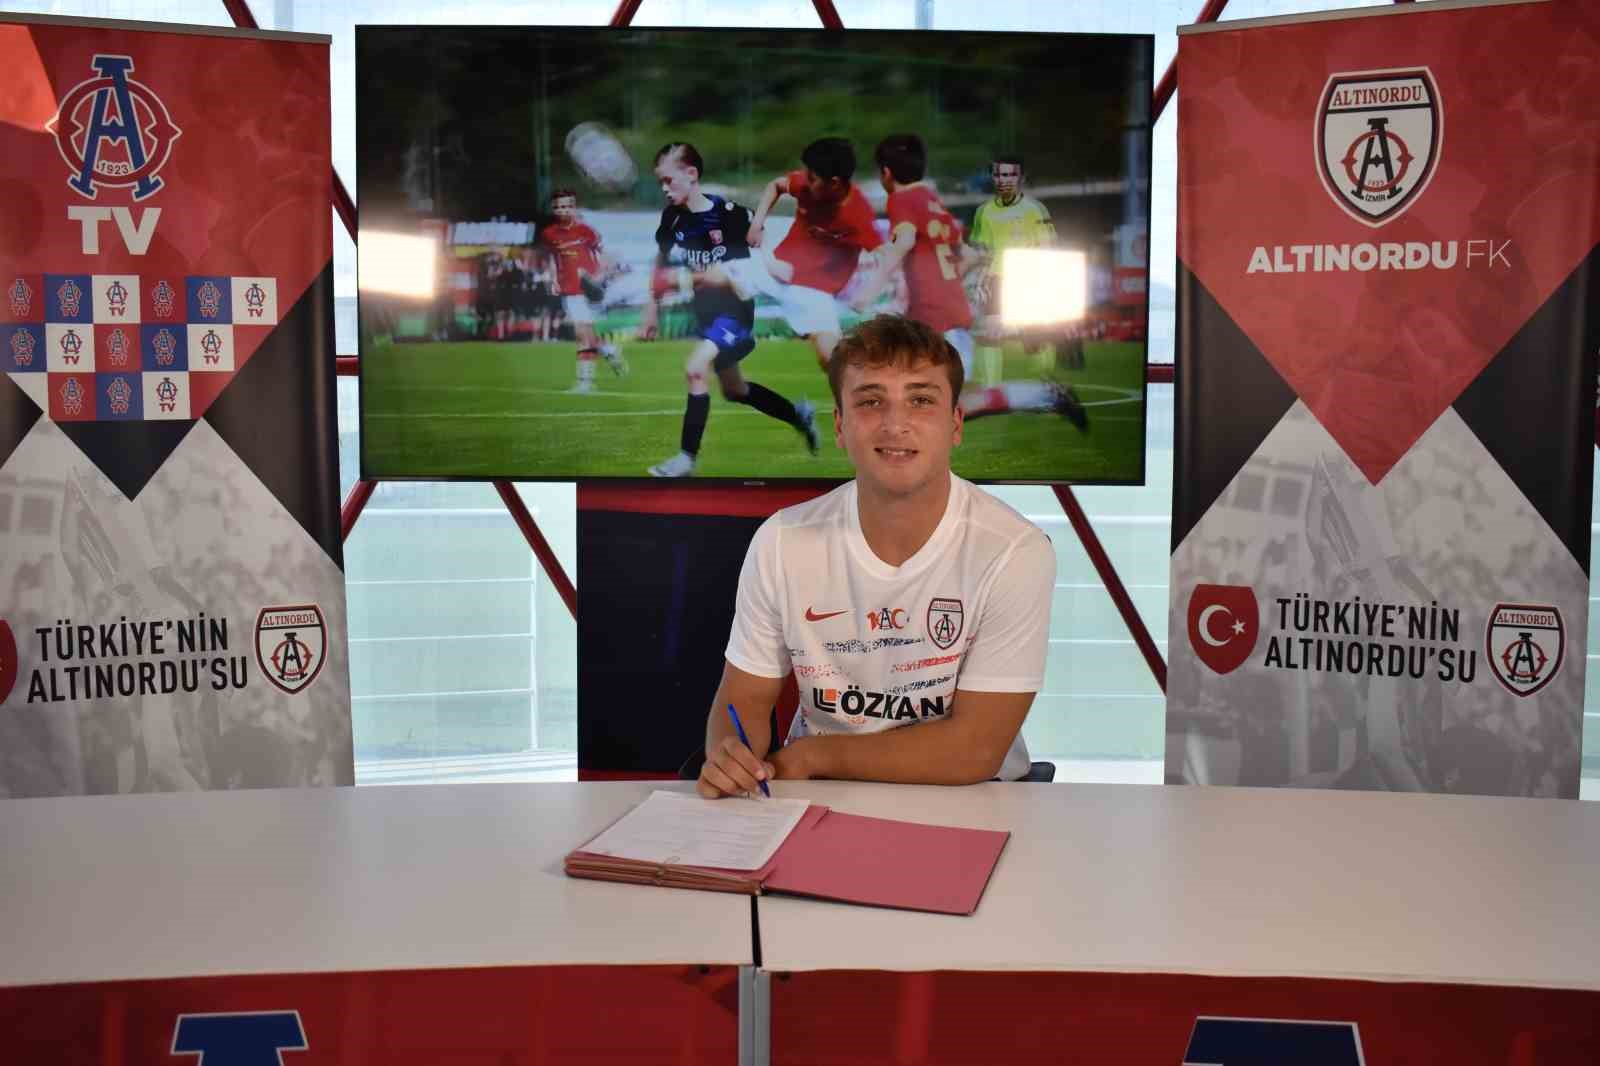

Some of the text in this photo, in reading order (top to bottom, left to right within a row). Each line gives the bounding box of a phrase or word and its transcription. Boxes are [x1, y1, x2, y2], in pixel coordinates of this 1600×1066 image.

[1332, 85, 1424, 107] ALTINORDU
[98, 160, 129, 176] 1923
[67, 206, 162, 255] TV
[1247, 239, 1513, 274] ALTINORDU FK
[109, 306, 125, 317] TV
[248, 308, 263, 317] TV
[62, 355, 80, 365] TV
[204, 354, 220, 365] TV
[159, 402, 176, 412] TV
[263, 613, 316, 626] ALTINORDU
[1276, 592, 1460, 642] TÜRKİYE'NİN
[1496, 612, 1555, 625] ALTINORDU
[35, 612, 229, 662] TÜRKİYE'NİN
[1263, 635, 1477, 683] ALTINORDU'SU
[27, 655, 249, 704] ALTINORDU'SU
[840, 684, 945, 721] ÖZKAN
